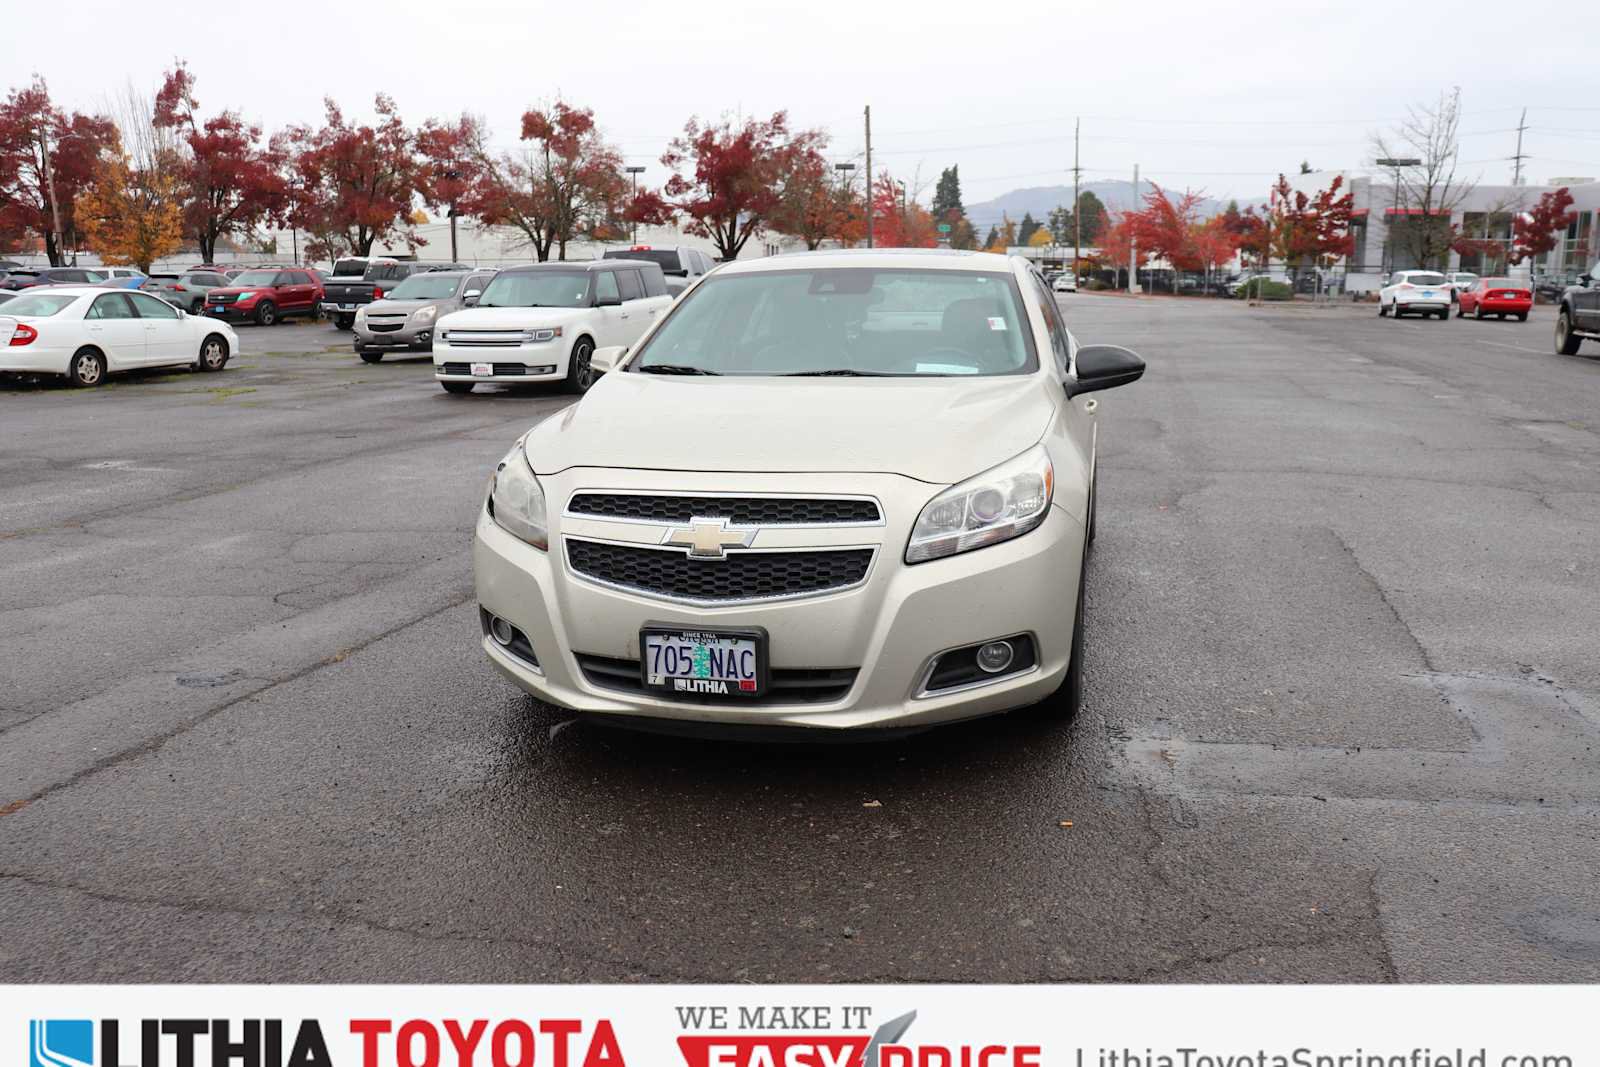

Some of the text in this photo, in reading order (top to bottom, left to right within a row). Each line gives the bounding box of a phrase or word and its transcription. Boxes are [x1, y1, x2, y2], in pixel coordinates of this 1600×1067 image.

[648, 644, 754, 679] 705 NAC
[686, 679, 729, 694] LITHIA
